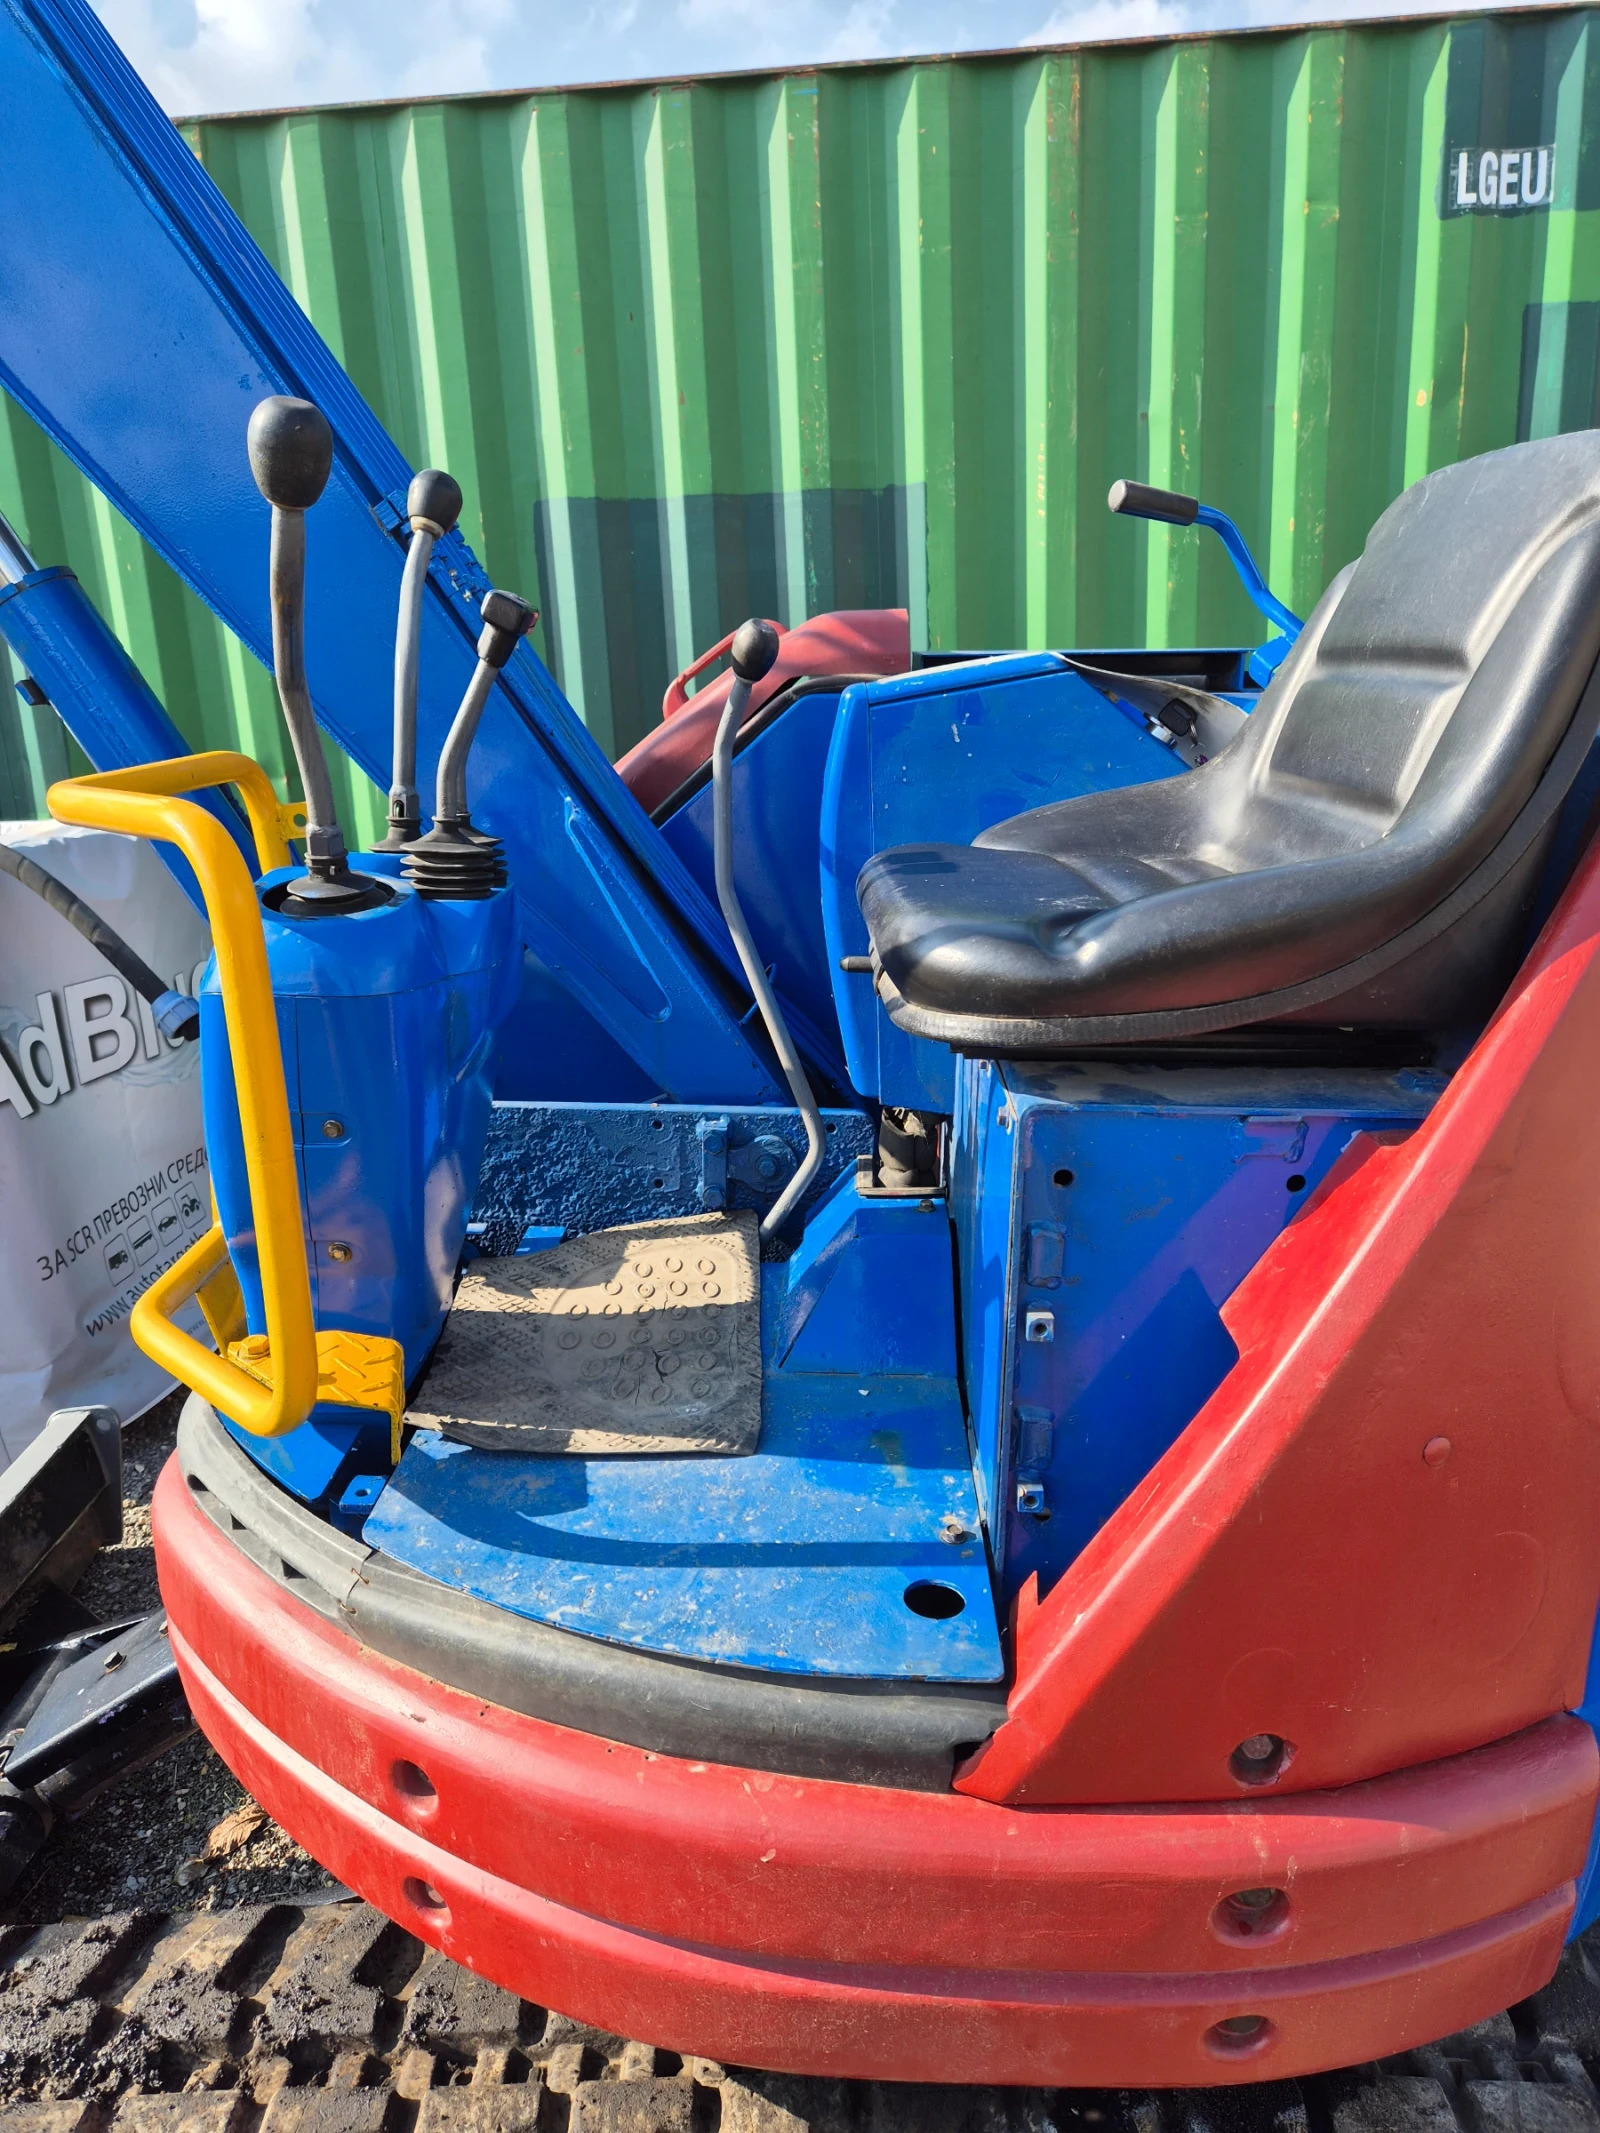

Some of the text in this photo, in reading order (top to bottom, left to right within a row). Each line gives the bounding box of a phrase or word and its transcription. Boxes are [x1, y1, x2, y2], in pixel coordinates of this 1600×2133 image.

[1457, 150, 1548, 205] LGEU
[0, 961, 206, 1119] dBl
[37, 1147, 208, 1281] ЗА SCR ПРЕВОЗНИ СРЕД
